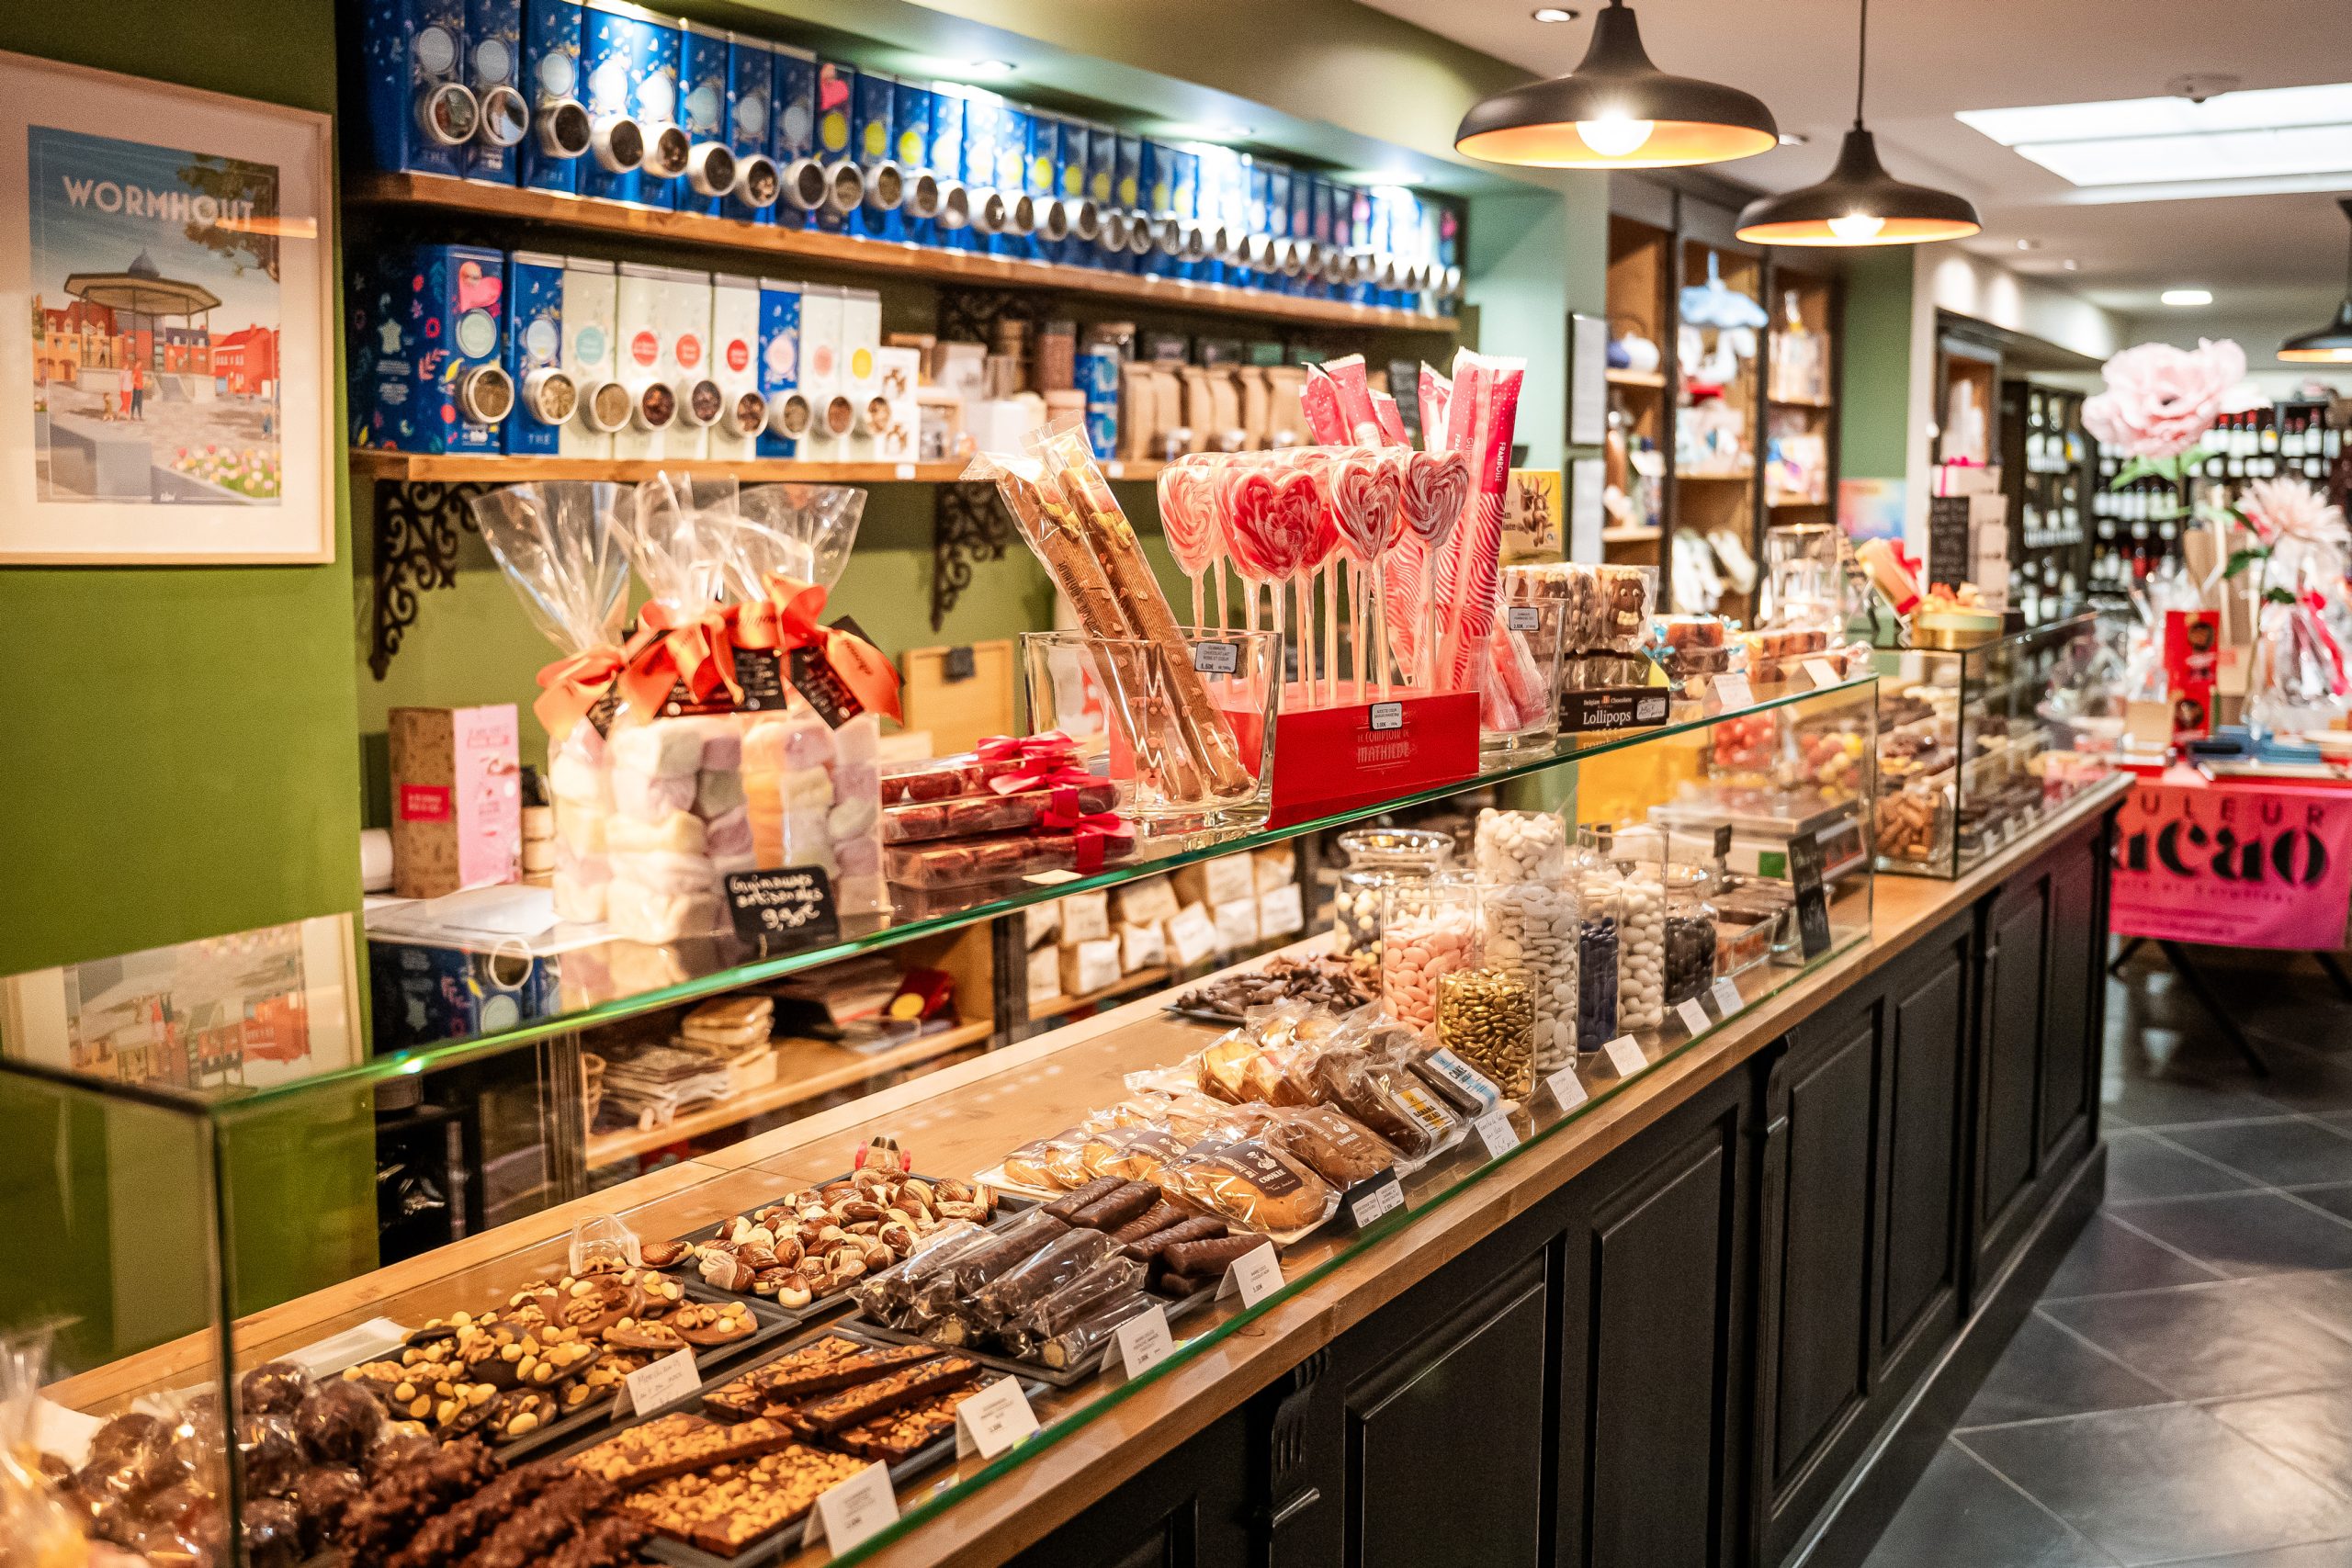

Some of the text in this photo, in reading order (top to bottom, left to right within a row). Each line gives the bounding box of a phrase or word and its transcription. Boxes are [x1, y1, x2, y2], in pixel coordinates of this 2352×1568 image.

[62, 175, 254, 231] WORMHOUT
[1495, 441, 1507, 483] FRAMBOISE
[1582, 709, 1632, 727] Lollipops
[1365, 728, 1401, 743] COMPTOIR
[1357, 740, 1410, 763] MATHILDE
[2140, 793, 2324, 826] ULEUR
[1449, 1065, 1467, 1079] CAKE
[1413, 1105, 1436, 1117] BANANA
[1422, 1111, 1441, 1122] BREAD
[1258, 1168, 1286, 1184] COOKIE
